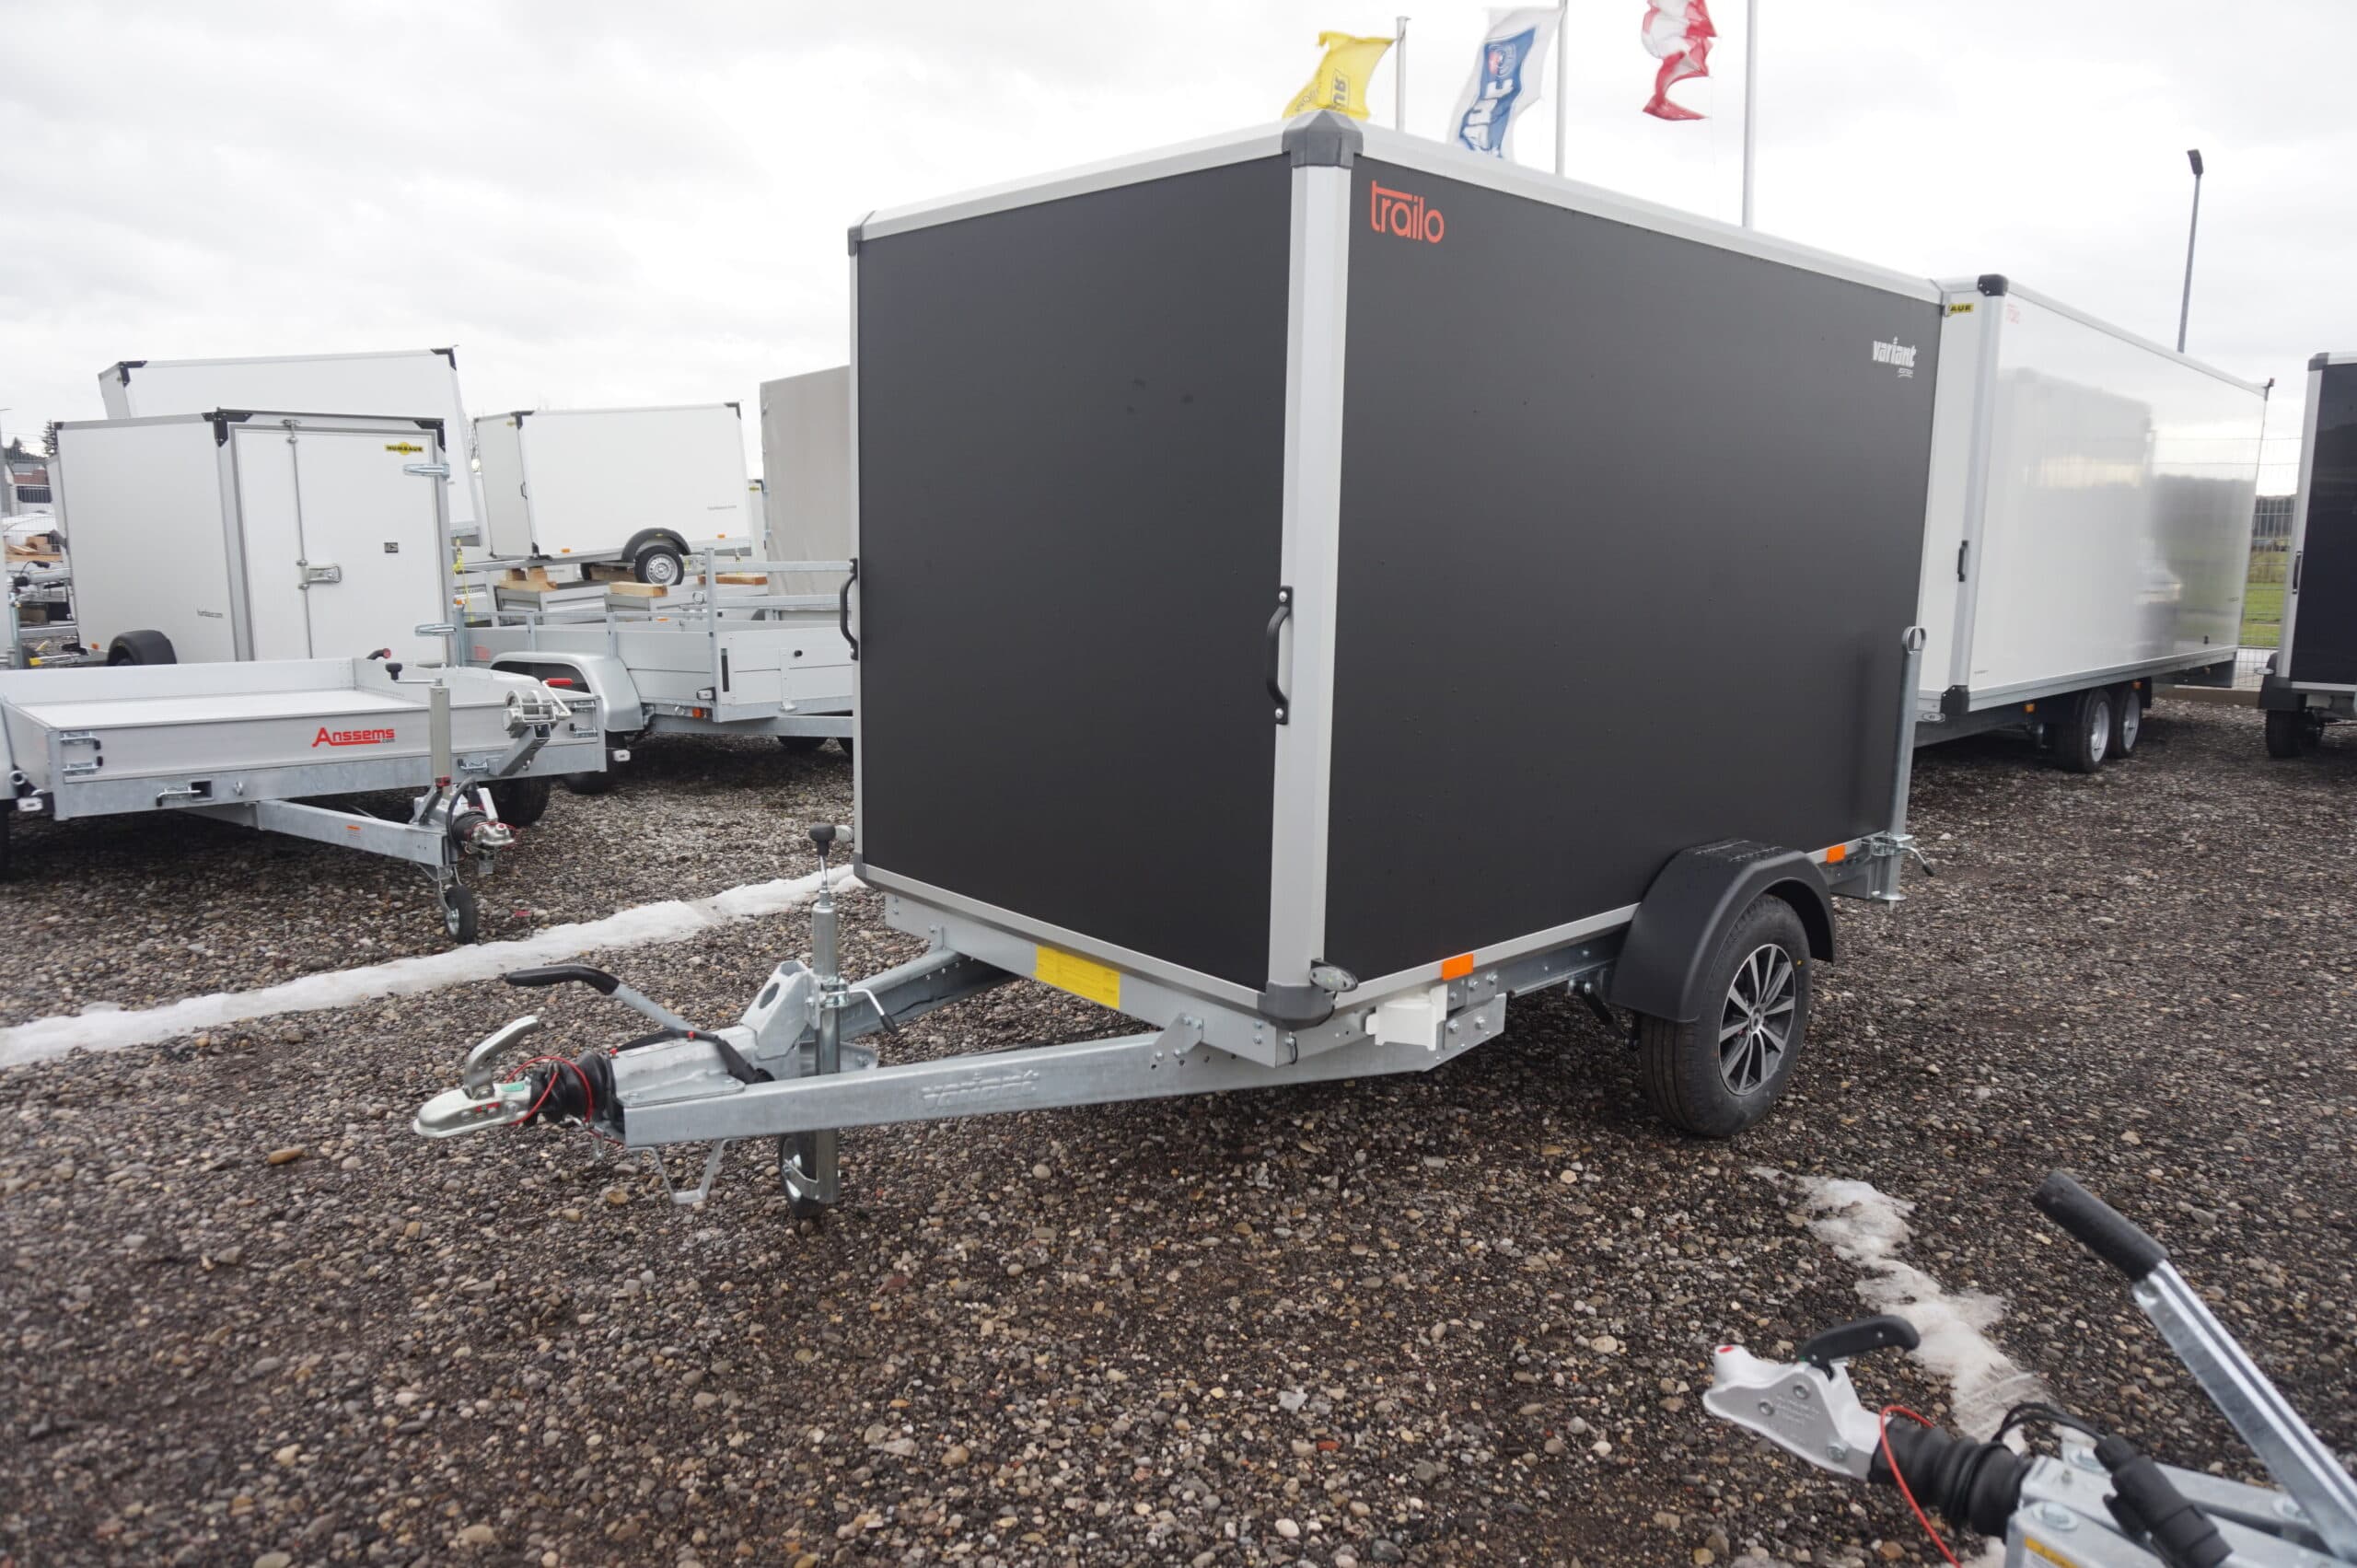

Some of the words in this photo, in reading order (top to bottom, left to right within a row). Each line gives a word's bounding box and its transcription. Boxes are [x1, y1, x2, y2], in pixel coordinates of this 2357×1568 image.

[1371, 180, 1445, 244] trailo
[1873, 336, 1917, 368] variant
[311, 726, 395, 748] Anssems
